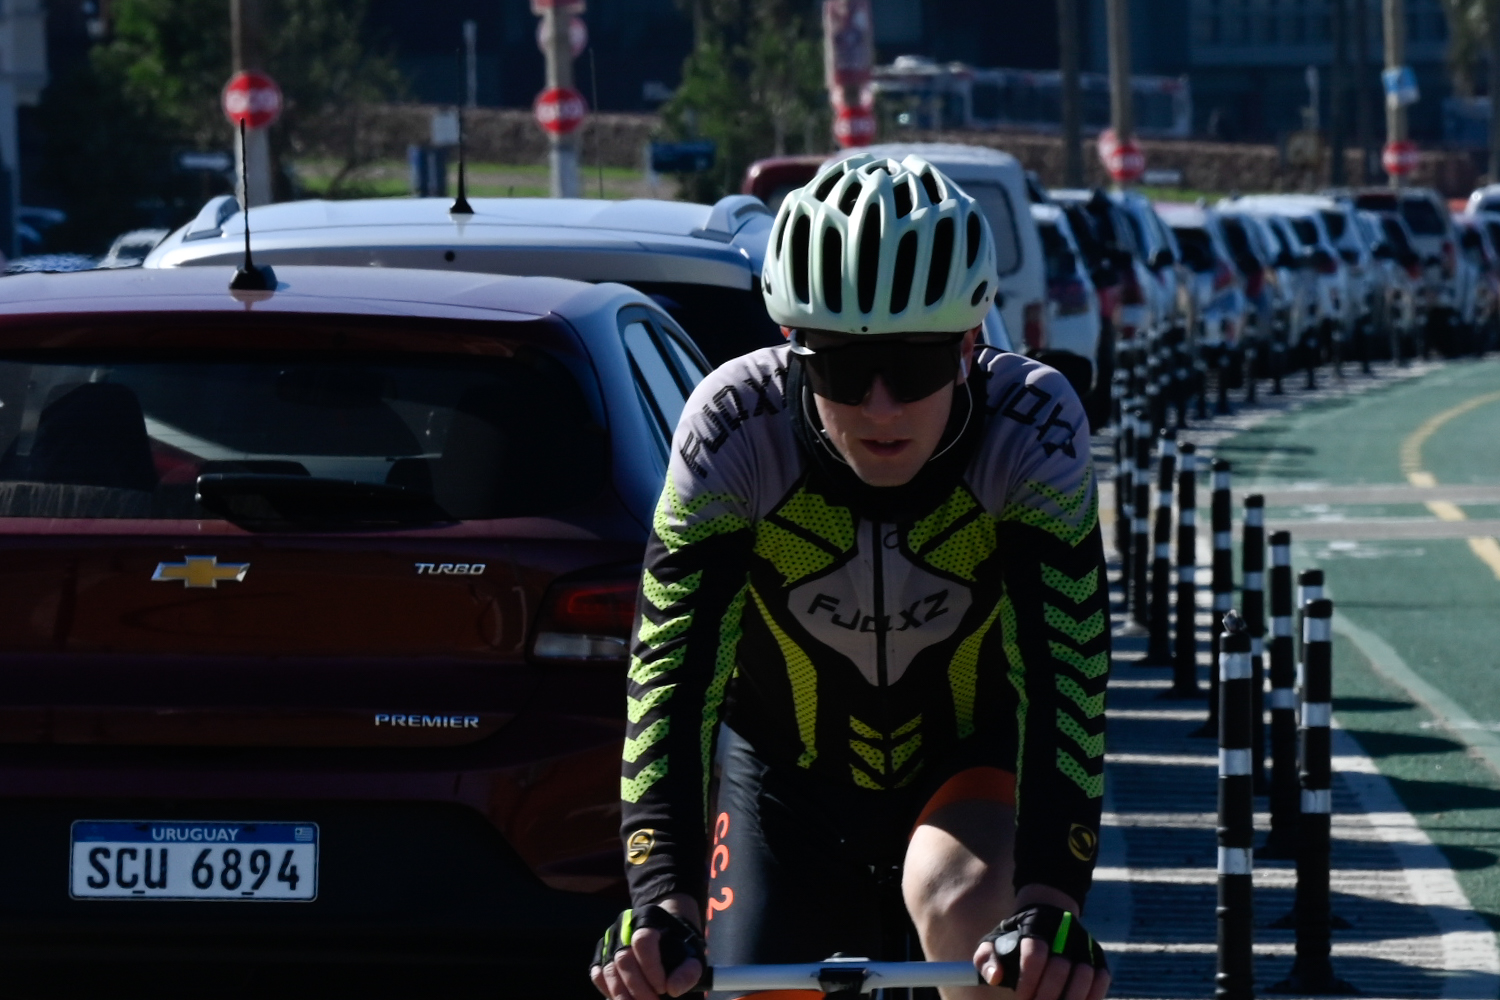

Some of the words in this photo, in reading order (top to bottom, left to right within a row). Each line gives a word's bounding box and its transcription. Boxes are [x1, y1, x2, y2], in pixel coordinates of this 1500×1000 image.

[414, 562, 487, 575] TURBO
[374, 713, 480, 728] PREMIER
[151, 827, 240, 842] URUGUAY
[86, 846, 168, 890] SCU
[191, 848, 300, 891] 6894
